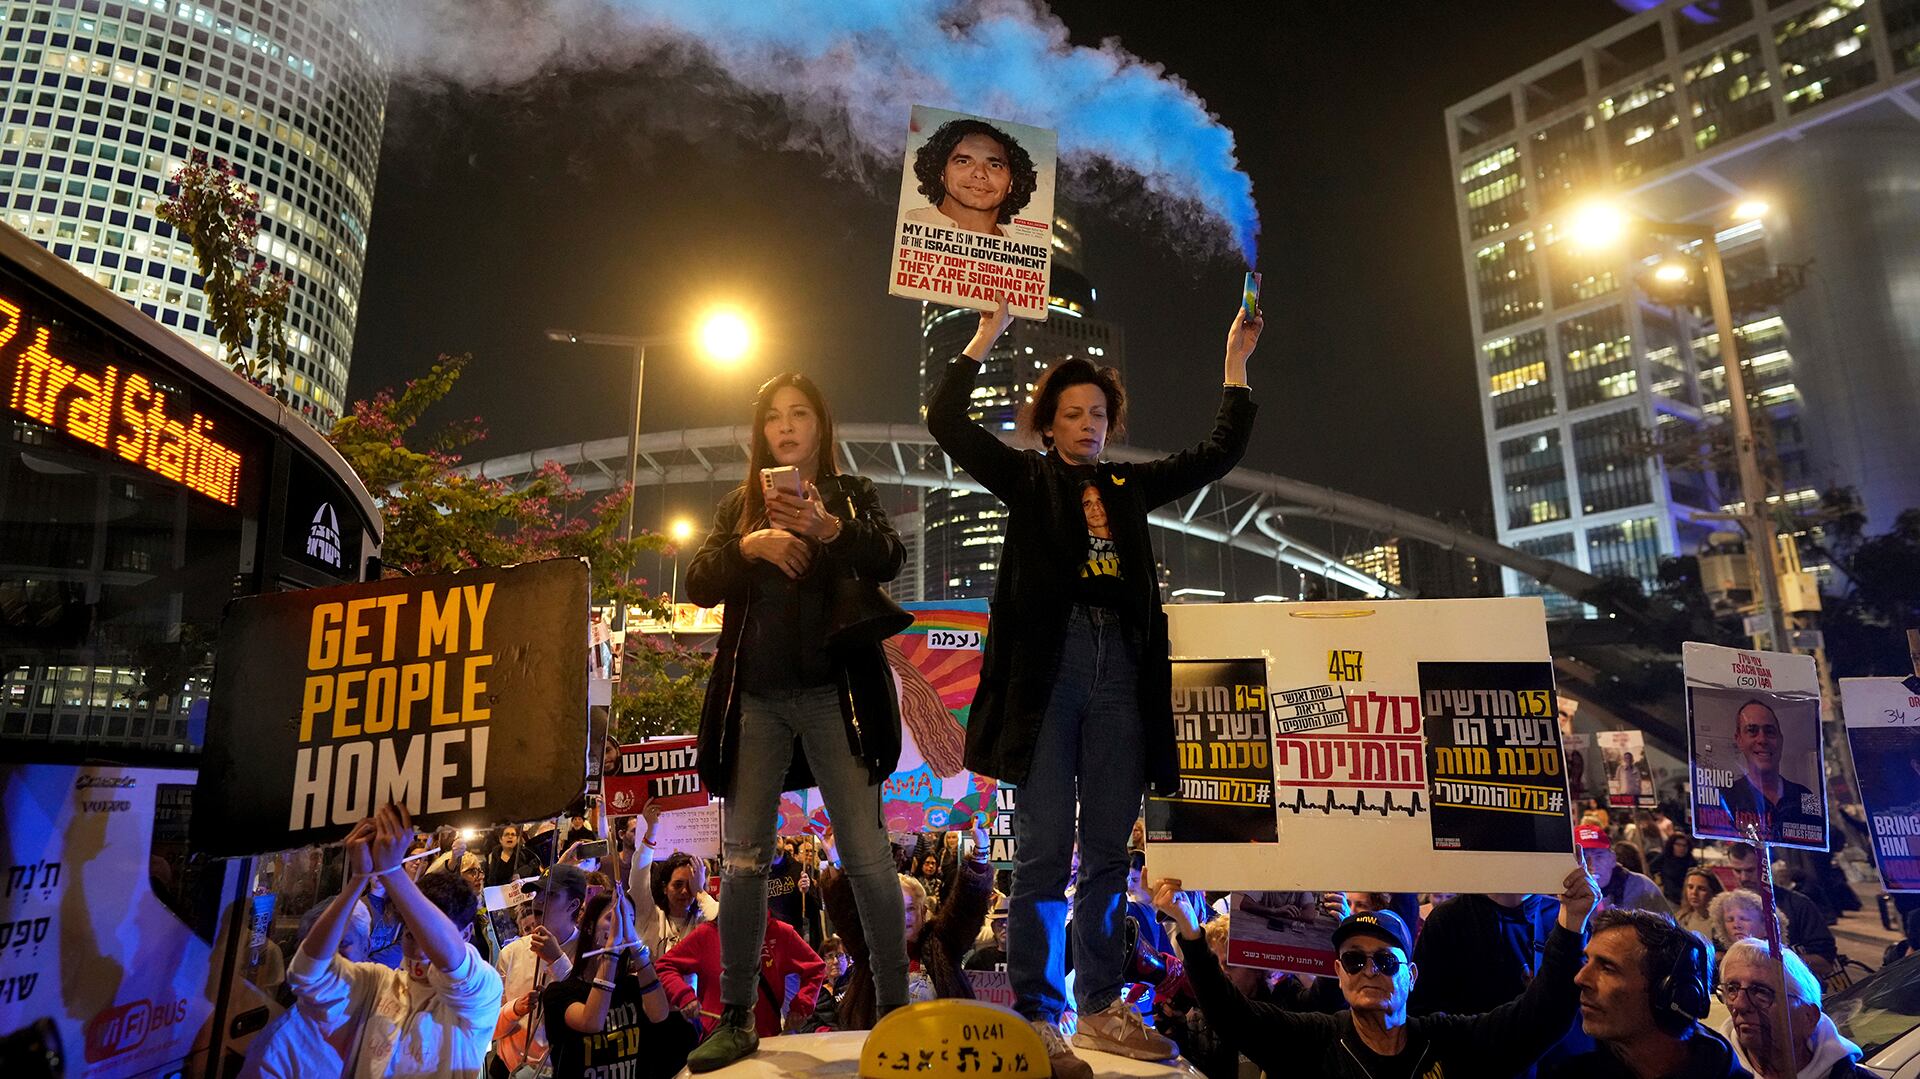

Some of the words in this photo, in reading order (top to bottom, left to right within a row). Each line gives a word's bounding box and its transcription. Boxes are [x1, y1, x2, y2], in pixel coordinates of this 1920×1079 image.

[901, 236, 910, 246] OF
[911, 237, 923, 249] THE
[924, 240, 969, 257] ISRAELI
[970, 249, 1047, 271] GOVERNMENT
[902, 222, 923, 235] MY
[924, 227, 954, 242] LIFE
[955, 232, 964, 243] IS
[965, 234, 973, 246] IN
[975, 236, 1000, 250] THE
[1003, 241, 1047, 259] HANDS
[899, 259, 934, 275] THEY
[936, 266, 966, 281] ARE
[968, 272, 1022, 292] SIGNING
[1025, 281, 1046, 296] MY
[900, 248, 910, 259] IF
[910, 250, 942, 264] THEY
[943, 256, 977, 271] DON'T
[978, 261, 1003, 276] SIGN
[1005, 266, 1014, 277] A
[1016, 268, 1046, 284] DEAL
[896, 272, 953, 295] DEATH
[116, 373, 242, 507] Station
[307, 594, 408, 671] GET
[418, 583, 496, 657] MY
[931, 632, 979, 648] נעמה
[1329, 650, 1363, 682] 467
[298, 655, 493, 743] PEOPLE
[1295, 701, 1327, 716] בריאות
[1346, 691, 1421, 735] כולם
[1425, 689, 1517, 716] חודשים
[1519, 690, 1547, 716] 15
[1208, 713, 1267, 741] בשבי
[1283, 716, 1322, 732] החטופים
[1323, 712, 1345, 728] למען
[1452, 718, 1488, 746] הם
[1493, 718, 1557, 746] בשבי
[622, 745, 698, 773] לחופש
[1210, 742, 1268, 769] סכנת
[1276, 740, 1425, 782] הומניטרי
[1434, 747, 1492, 775] מוות
[1497, 747, 1560, 776] סכנת
[288, 726, 490, 832] HOME!
[656, 773, 700, 797] נולדו
[1696, 767, 1735, 789] BRING
[1434, 782, 1564, 812] #כולםהומניטרי
[1698, 786, 1721, 807] HIM
[1873, 815, 1920, 836] BRING
[1878, 836, 1910, 857] HIM
[1242, 949, 1260, 959] בשבי
[1262, 951, 1285, 962] להשאר
[1287, 954, 1295, 963] לו
[1296, 956, 1313, 965] תתנו
[1313, 958, 1324, 967] אל
[150, 999, 188, 1032] BUS
[583, 1027, 640, 1067] עדיין
